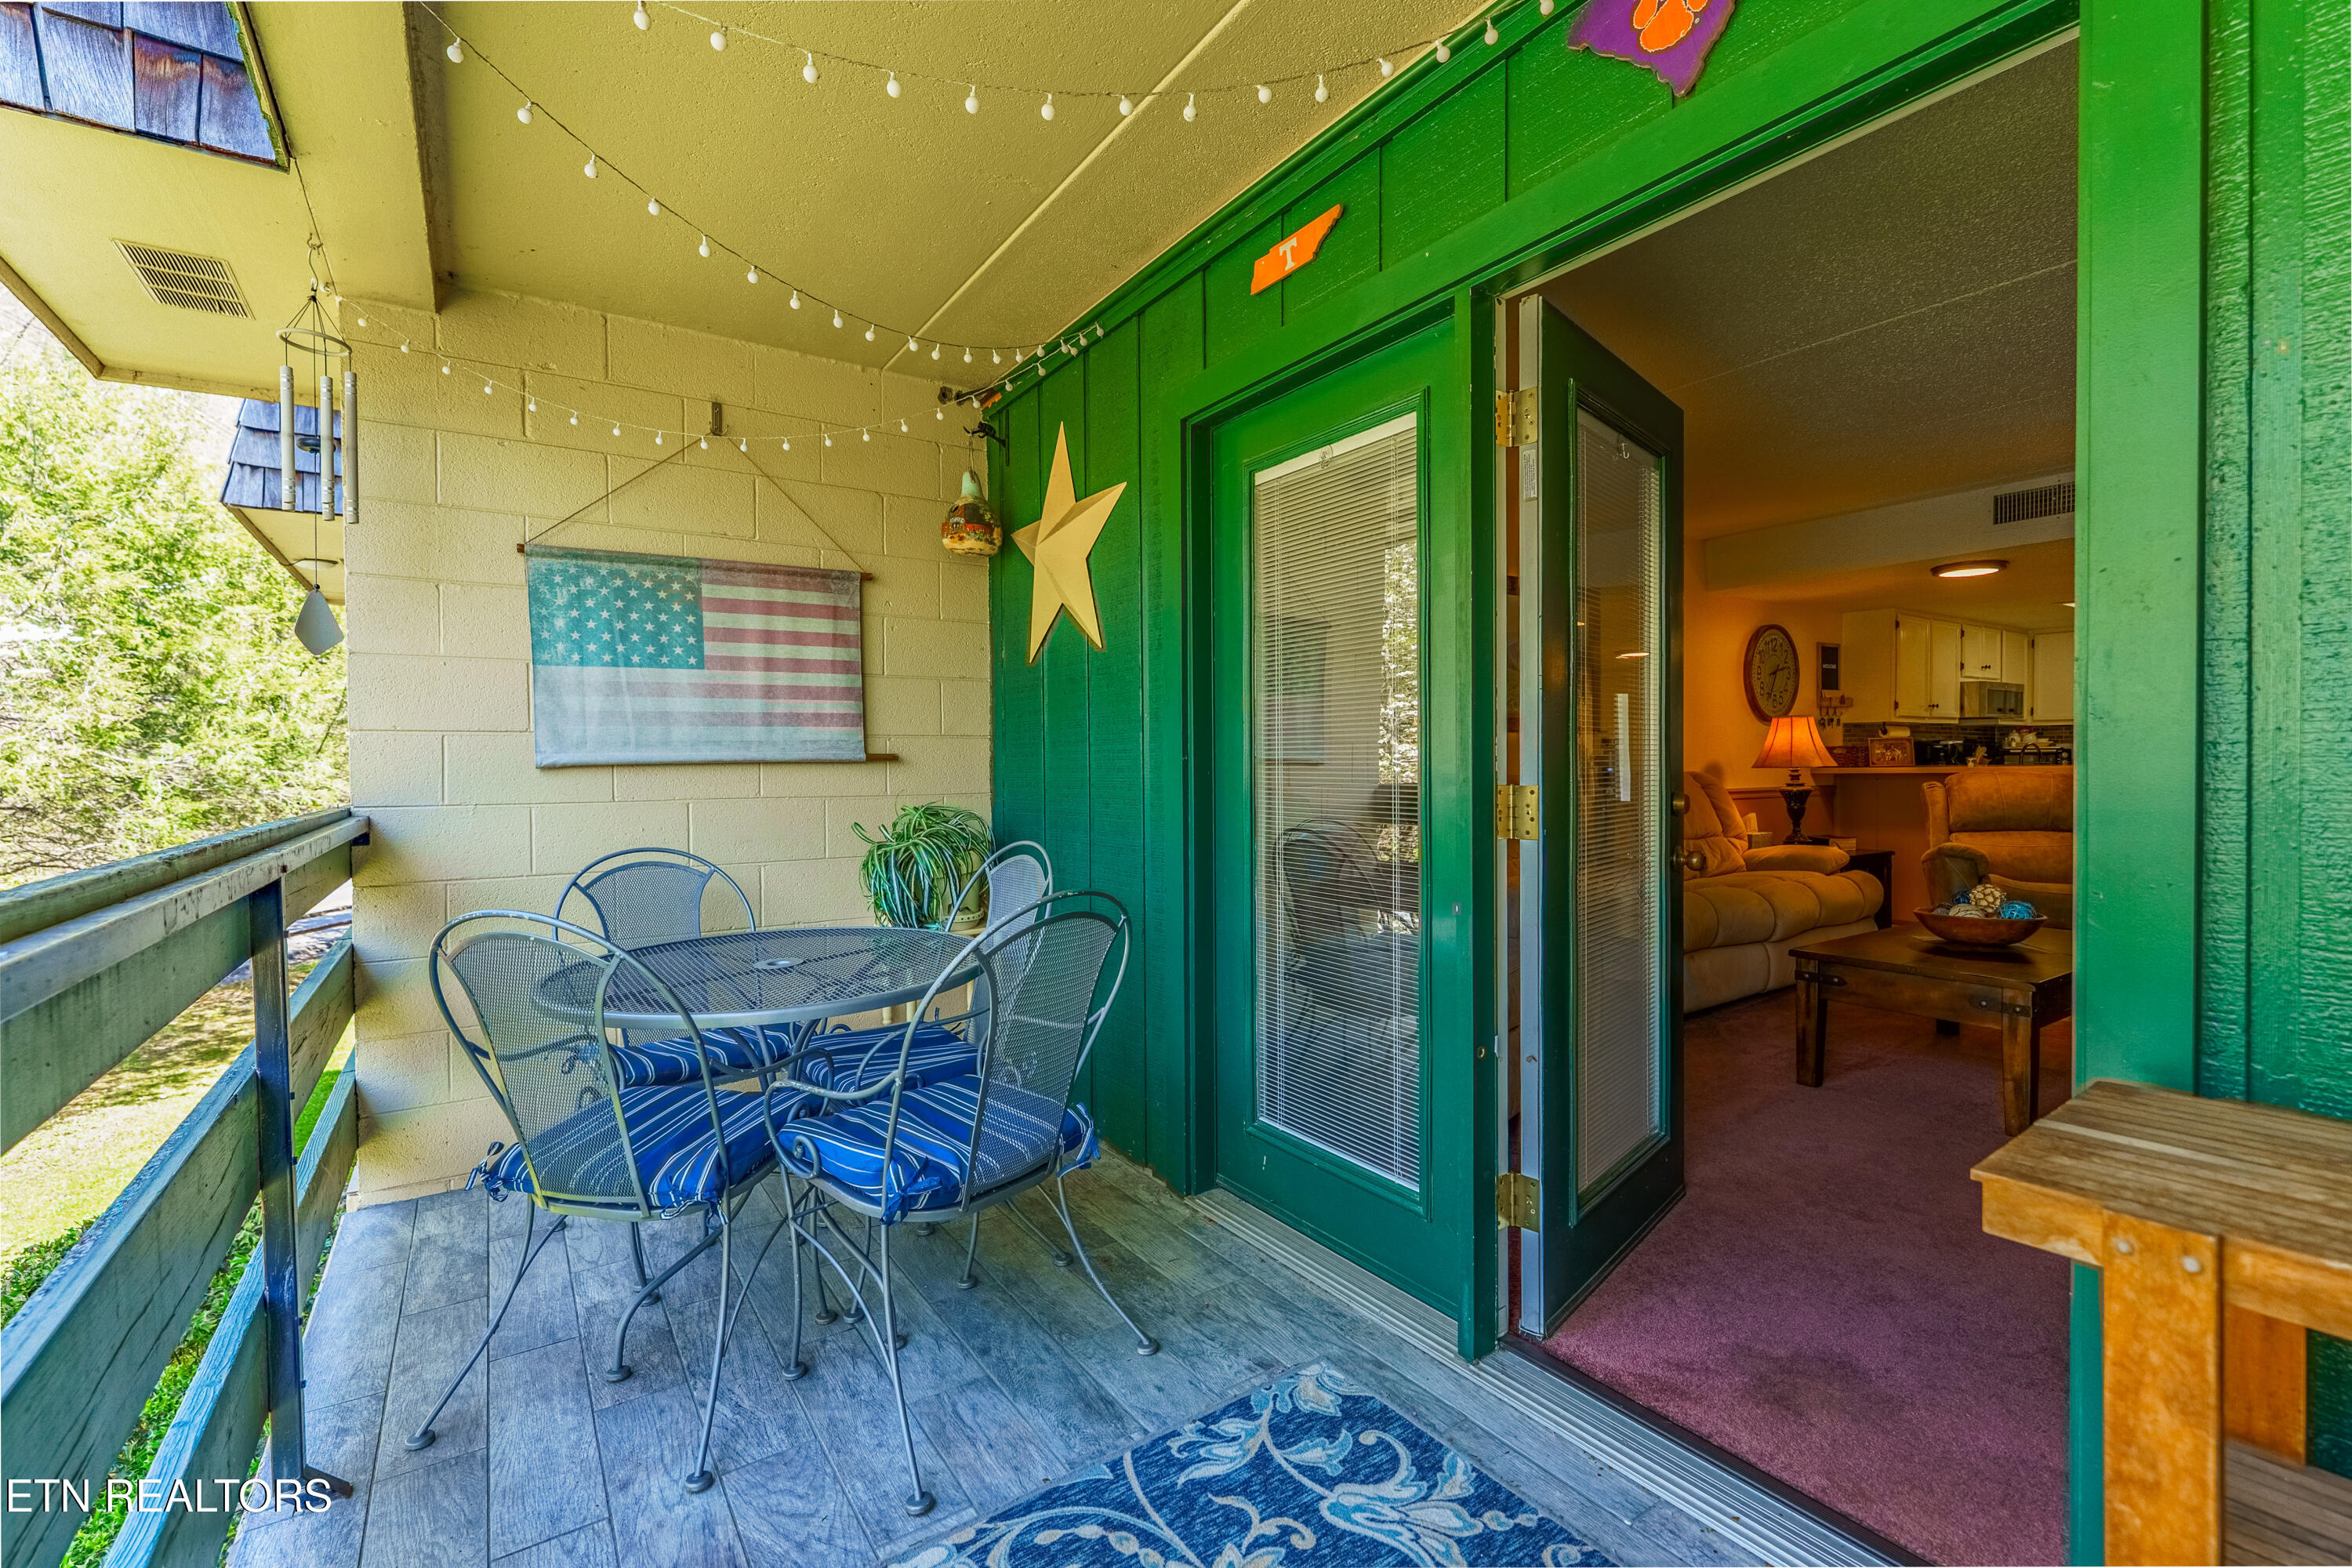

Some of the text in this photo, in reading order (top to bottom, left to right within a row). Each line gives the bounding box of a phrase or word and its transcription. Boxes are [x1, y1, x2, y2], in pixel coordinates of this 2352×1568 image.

[1279, 237, 1298, 271] T
[1771, 637, 1777, 652] 12
[1759, 650, 1766, 664] 10
[1784, 650, 1788, 664] 2
[1757, 666, 1762, 681] 9
[1787, 666, 1791, 681] 3
[1759, 681, 1765, 696] 8
[1783, 681, 1788, 692] 4
[1773, 694, 1777, 708] 6
[1778, 691, 1784, 706] 5
